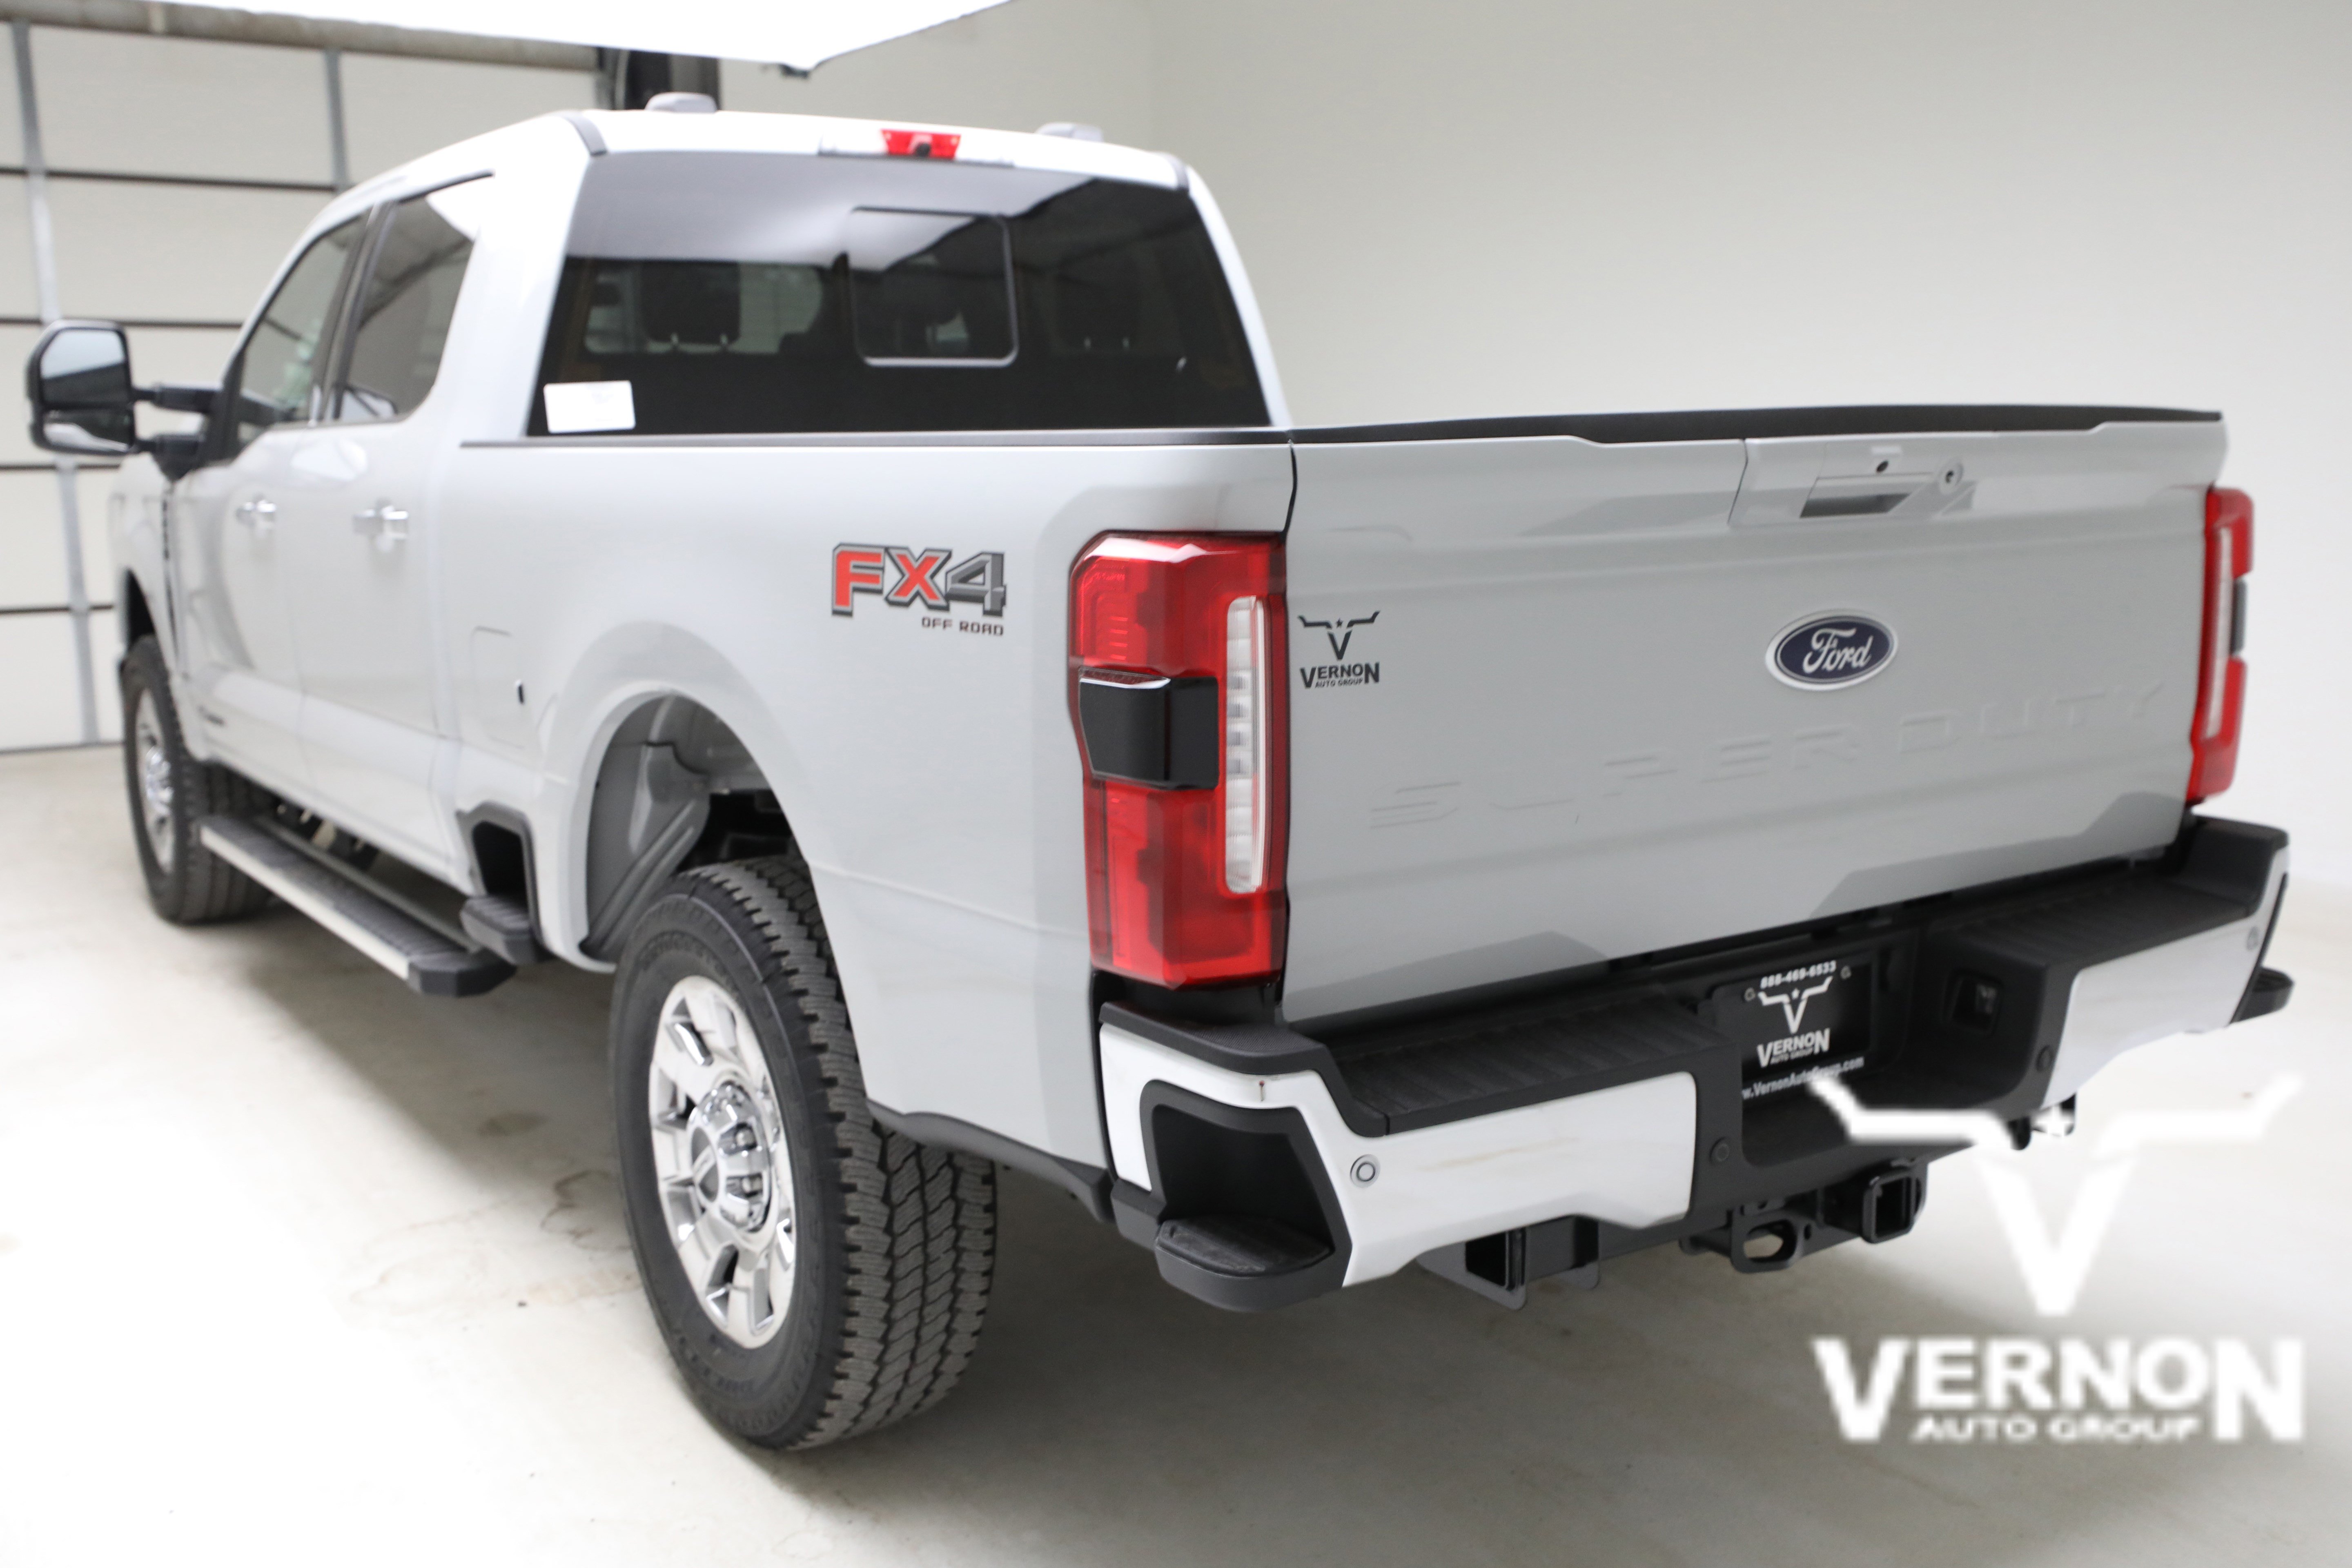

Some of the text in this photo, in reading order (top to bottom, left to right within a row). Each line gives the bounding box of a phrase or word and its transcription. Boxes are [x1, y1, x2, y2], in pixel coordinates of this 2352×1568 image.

[831, 542, 1007, 617] FX4
[922, 616, 1004, 637] OFF ROAD
[1802, 627, 1874, 674] Ford
[1300, 661, 1380, 689] VERNON
[1314, 677, 1363, 688] AUTO GROUP
[1757, 1027, 1831, 1068] VERNON
